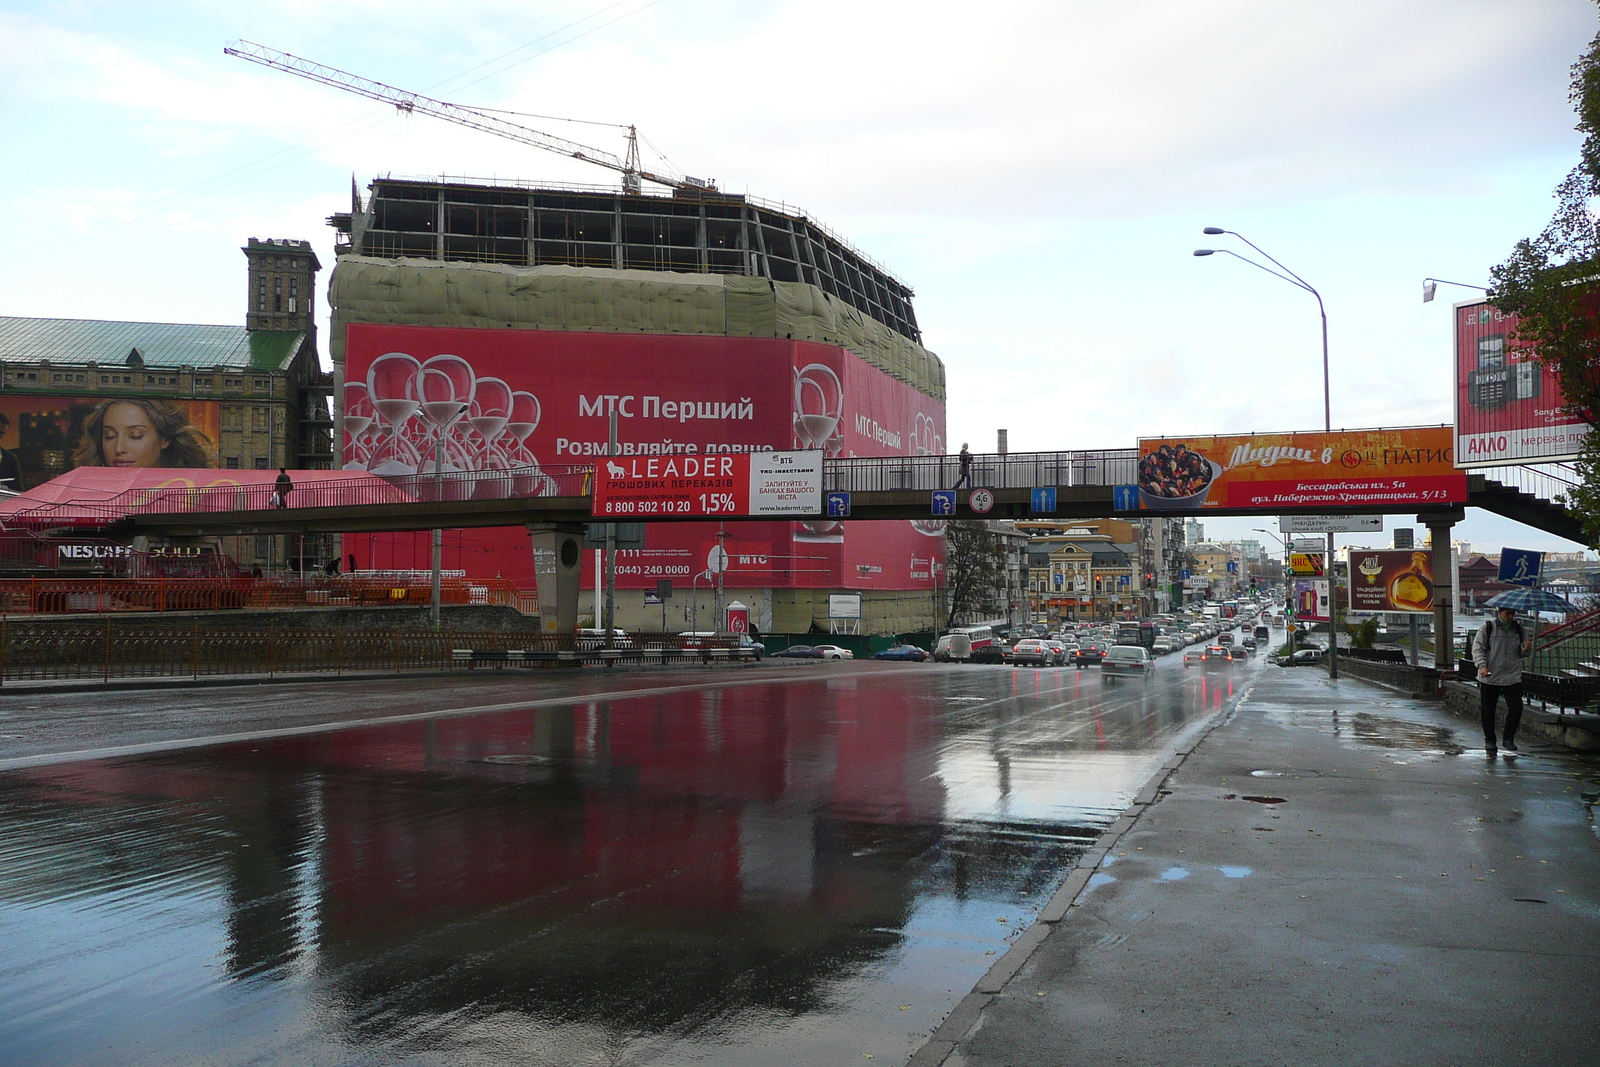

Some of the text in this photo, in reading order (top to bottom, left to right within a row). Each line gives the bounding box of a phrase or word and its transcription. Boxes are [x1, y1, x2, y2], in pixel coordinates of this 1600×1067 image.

[579, 394, 754, 422] МТС Перший
[1533, 408, 1554, 417] Sony
[855, 412, 902, 450] МТС Перший
[556, 437, 698, 456] Розмовляйте
[1468, 436, 1508, 454] АЛЛО
[1521, 434, 1565, 447] мережа
[780, 457, 794, 465] ВТБ
[1320, 447, 1333, 464] в
[632, 456, 734, 479] LEADER
[606, 479, 734, 490] ГРОШОВИХ ПЕРЕКАЗІВ
[765, 480, 809, 488] ЗАПИТУЙТЕ У
[1296, 481, 1406, 492] Бессарабська пл., 5а
[975, 494, 988, 503] 4,6
[1251, 488, 1448, 504] вул. Набережно-Хрещатицька, 5/13
[605, 492, 736, 515] 8 800 502 10 20 1,5%
[620, 549, 640, 558] 111
[739, 554, 768, 565] МТС
[644, 565, 663, 574] 240
[665, 565, 690, 574] 0000
